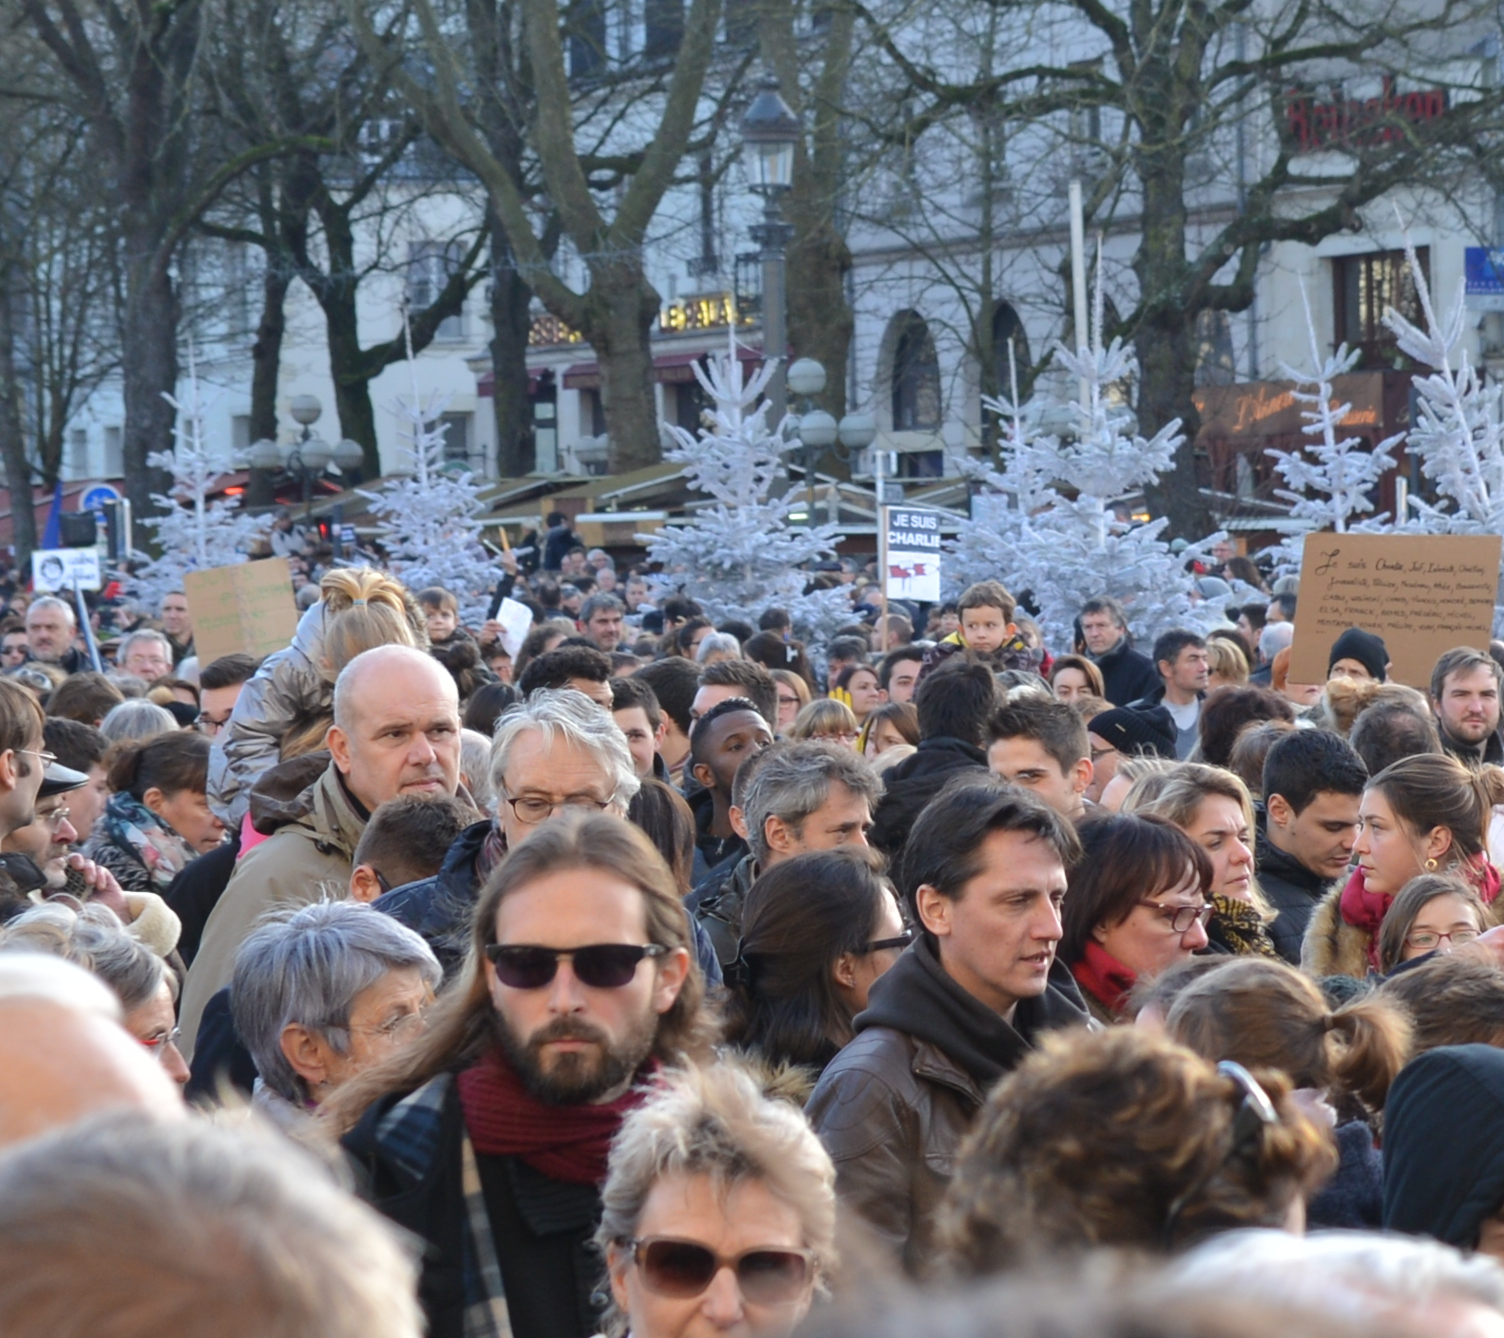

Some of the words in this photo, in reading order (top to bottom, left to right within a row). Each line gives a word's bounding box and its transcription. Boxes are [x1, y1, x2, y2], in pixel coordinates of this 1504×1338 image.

[893, 513, 909, 527] JE
[910, 515, 937, 529] SUIS
[888, 531, 940, 548] CHARLIE
[1314, 549, 1341, 576] Je
[1347, 559, 1367, 570] suis
